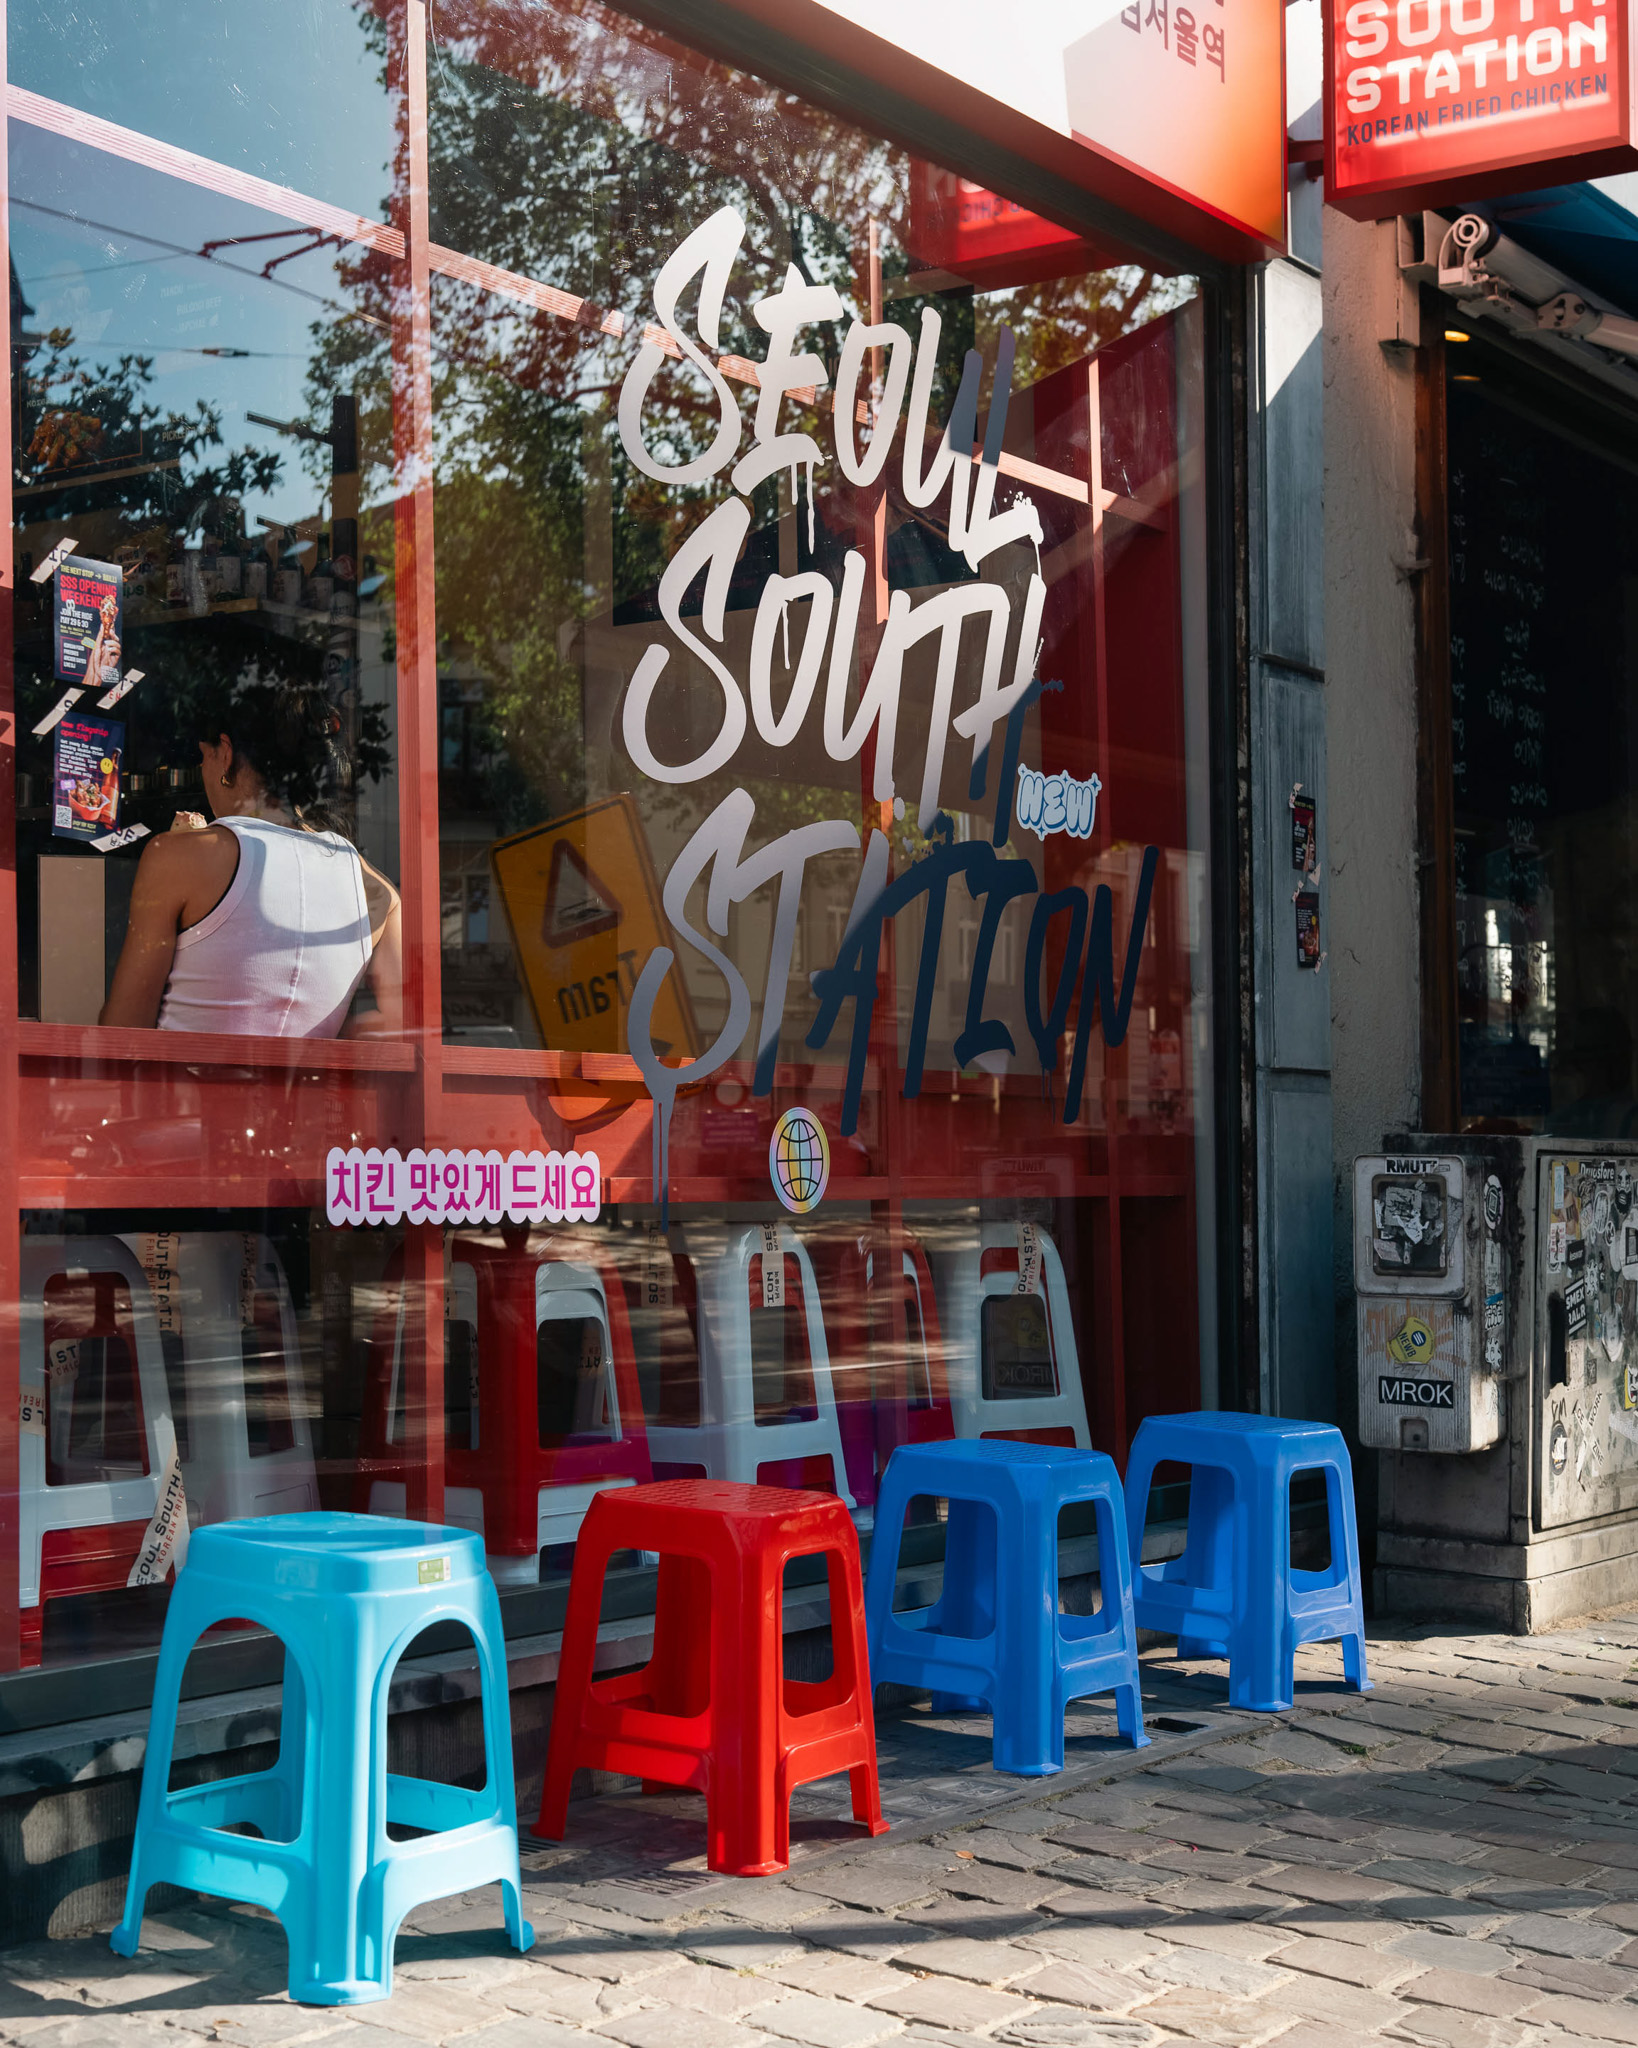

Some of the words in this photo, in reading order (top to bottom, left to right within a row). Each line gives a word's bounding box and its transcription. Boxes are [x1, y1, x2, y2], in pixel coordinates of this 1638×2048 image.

[1346, 0, 1605, 59] SOU
[1346, 15, 1608, 114] STATION
[1347, 110, 1429, 146] KOREAN
[1438, 96, 1501, 127] FRIED
[1511, 73, 1608, 113] CHICKEN
[60, 574, 78, 590] SSS
[79, 578, 117, 598] OPENING
[60, 588, 102, 609] WEEKEND
[1019, 774, 1094, 836] NEW
[332, 1161, 395, 1212] 치킨
[410, 1163, 501, 1212] 맛있게
[511, 1164, 596, 1210] 드세요
[1565, 1286, 1585, 1310] SMEX
[1399, 1332, 1416, 1358] NEWB
[1381, 1379, 1452, 1405] MROK
[1588, 1392, 1603, 1427] WORK
[155, 1474, 180, 1536] SOUTH
[156, 1521, 177, 1564] KOREAN
